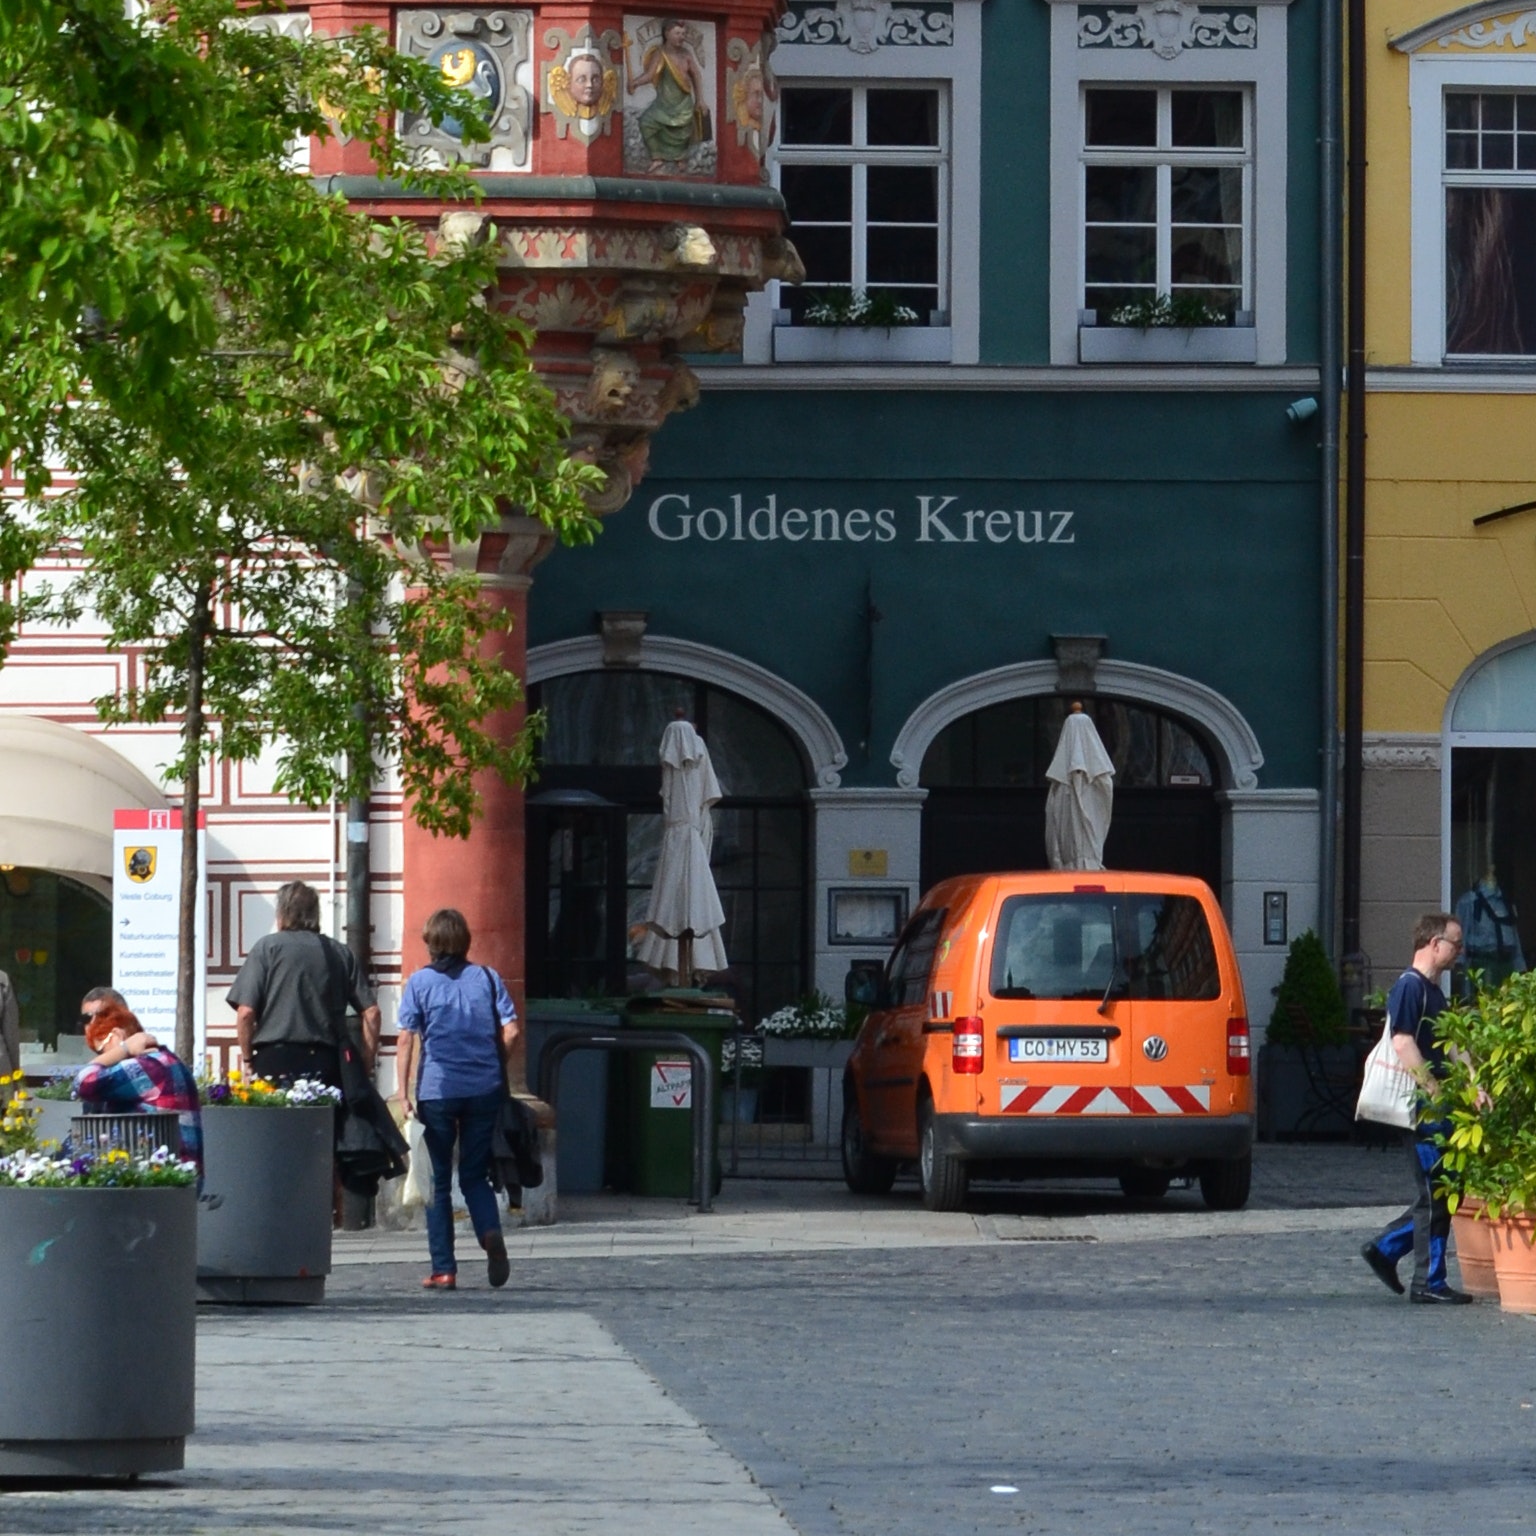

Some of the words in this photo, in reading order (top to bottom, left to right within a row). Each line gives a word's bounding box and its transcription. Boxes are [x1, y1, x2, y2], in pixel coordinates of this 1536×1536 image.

[647, 493, 896, 542] Goldenes
[915, 495, 1076, 544] Kreuz
[143, 892, 173, 903] Coburg
[119, 951, 166, 960] Kunstverein
[119, 969, 175, 978] Landestheater
[152, 988, 178, 996] Ehren
[1023, 1040, 1045, 1057] CO
[1056, 1040, 1077, 1057] MY
[1080, 1040, 1100, 1057] 53
